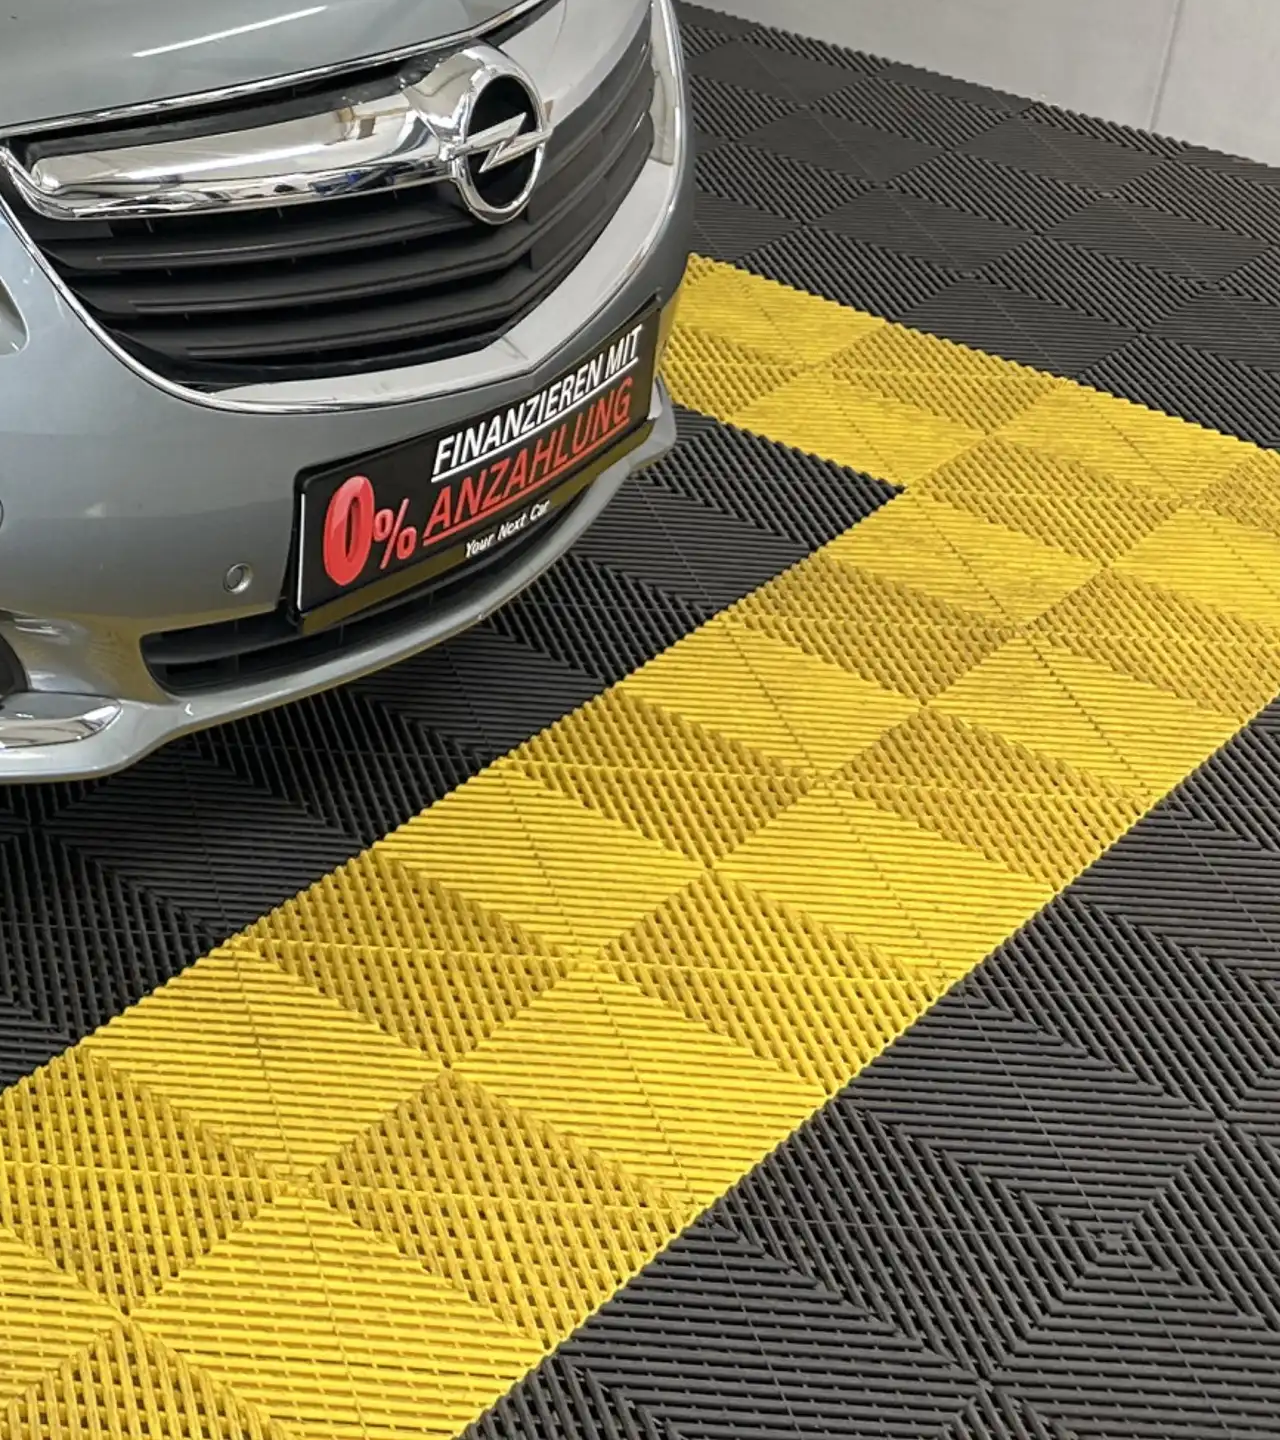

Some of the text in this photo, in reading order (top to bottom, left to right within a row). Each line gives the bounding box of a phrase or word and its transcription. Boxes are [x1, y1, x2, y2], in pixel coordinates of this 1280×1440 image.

[431, 323, 642, 477] FINANZIEREN MIT
[323, 376, 633, 586] 0% ANZAHLUNG
[464, 498, 551, 559] Your Next Car
